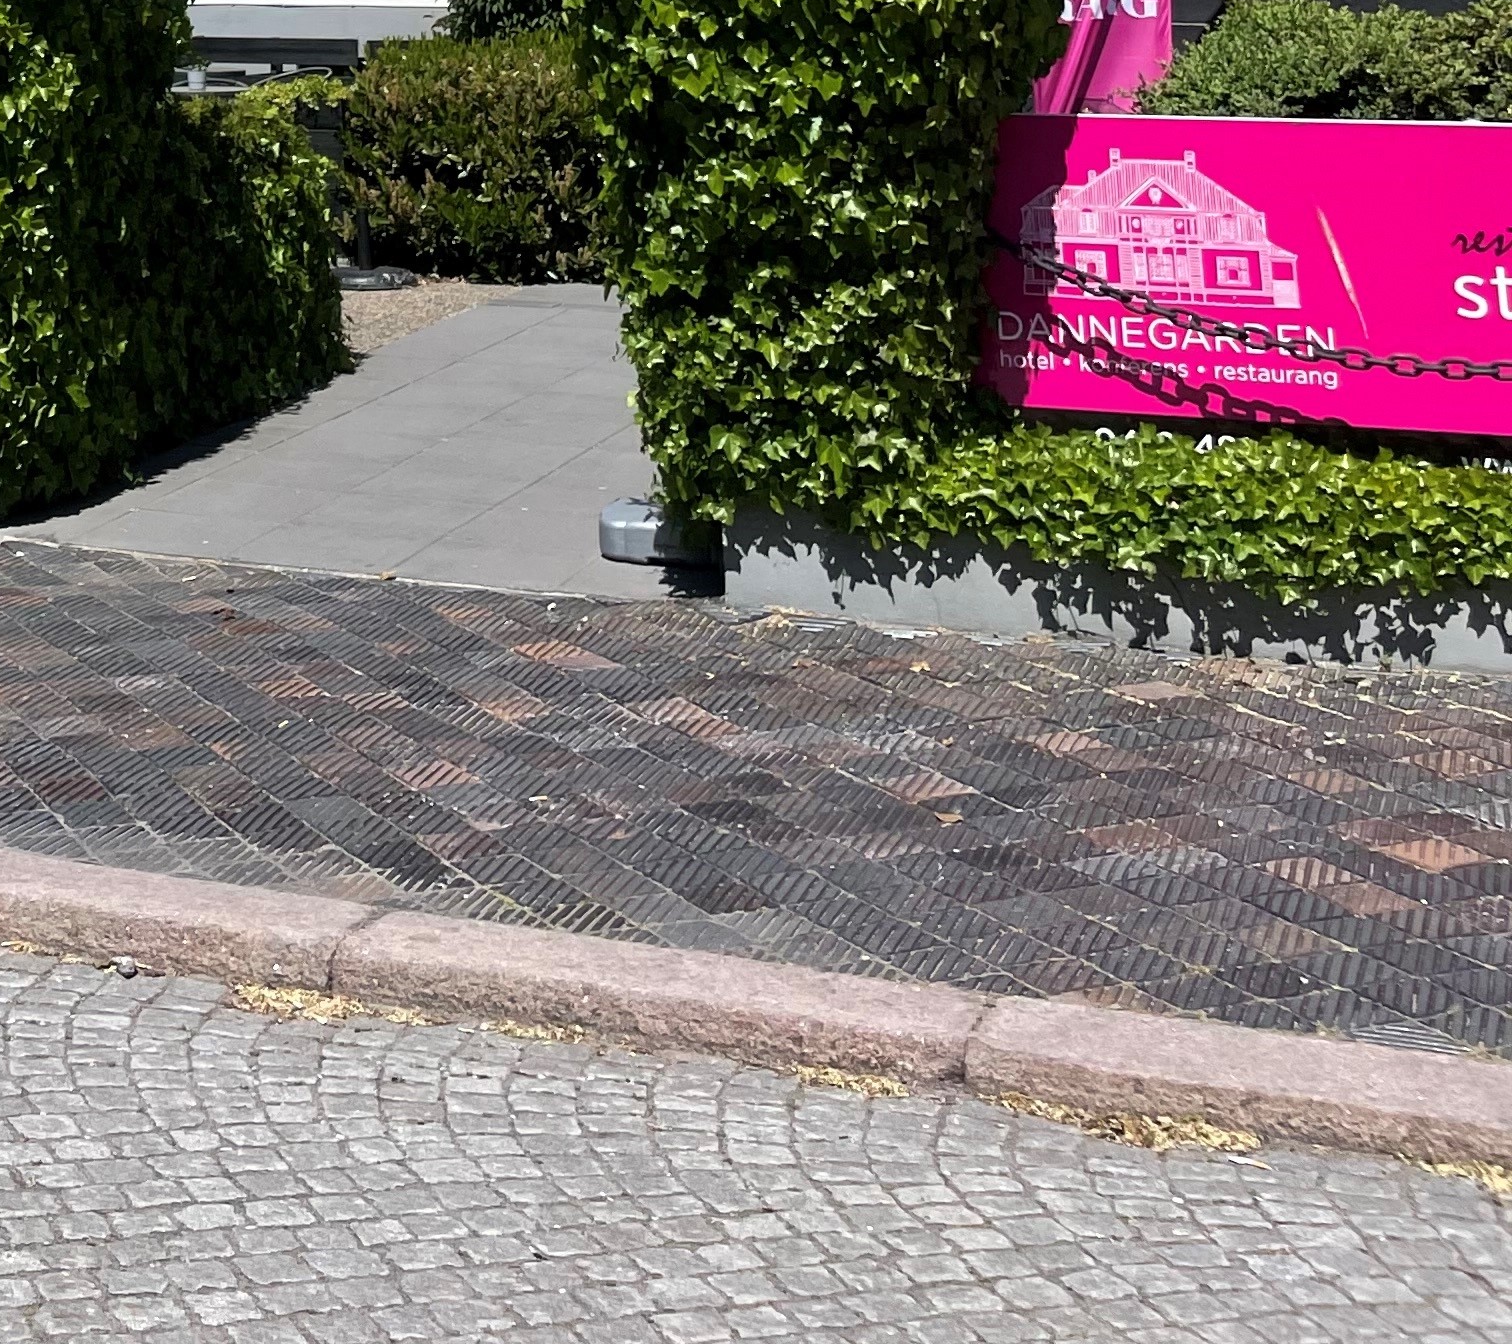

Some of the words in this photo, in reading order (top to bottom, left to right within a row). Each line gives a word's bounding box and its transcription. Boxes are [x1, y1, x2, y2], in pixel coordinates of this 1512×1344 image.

[999, 350, 1055, 370] hotel
[1079, 353, 1189, 378] konferens
[1214, 364, 1338, 390] restaurang
